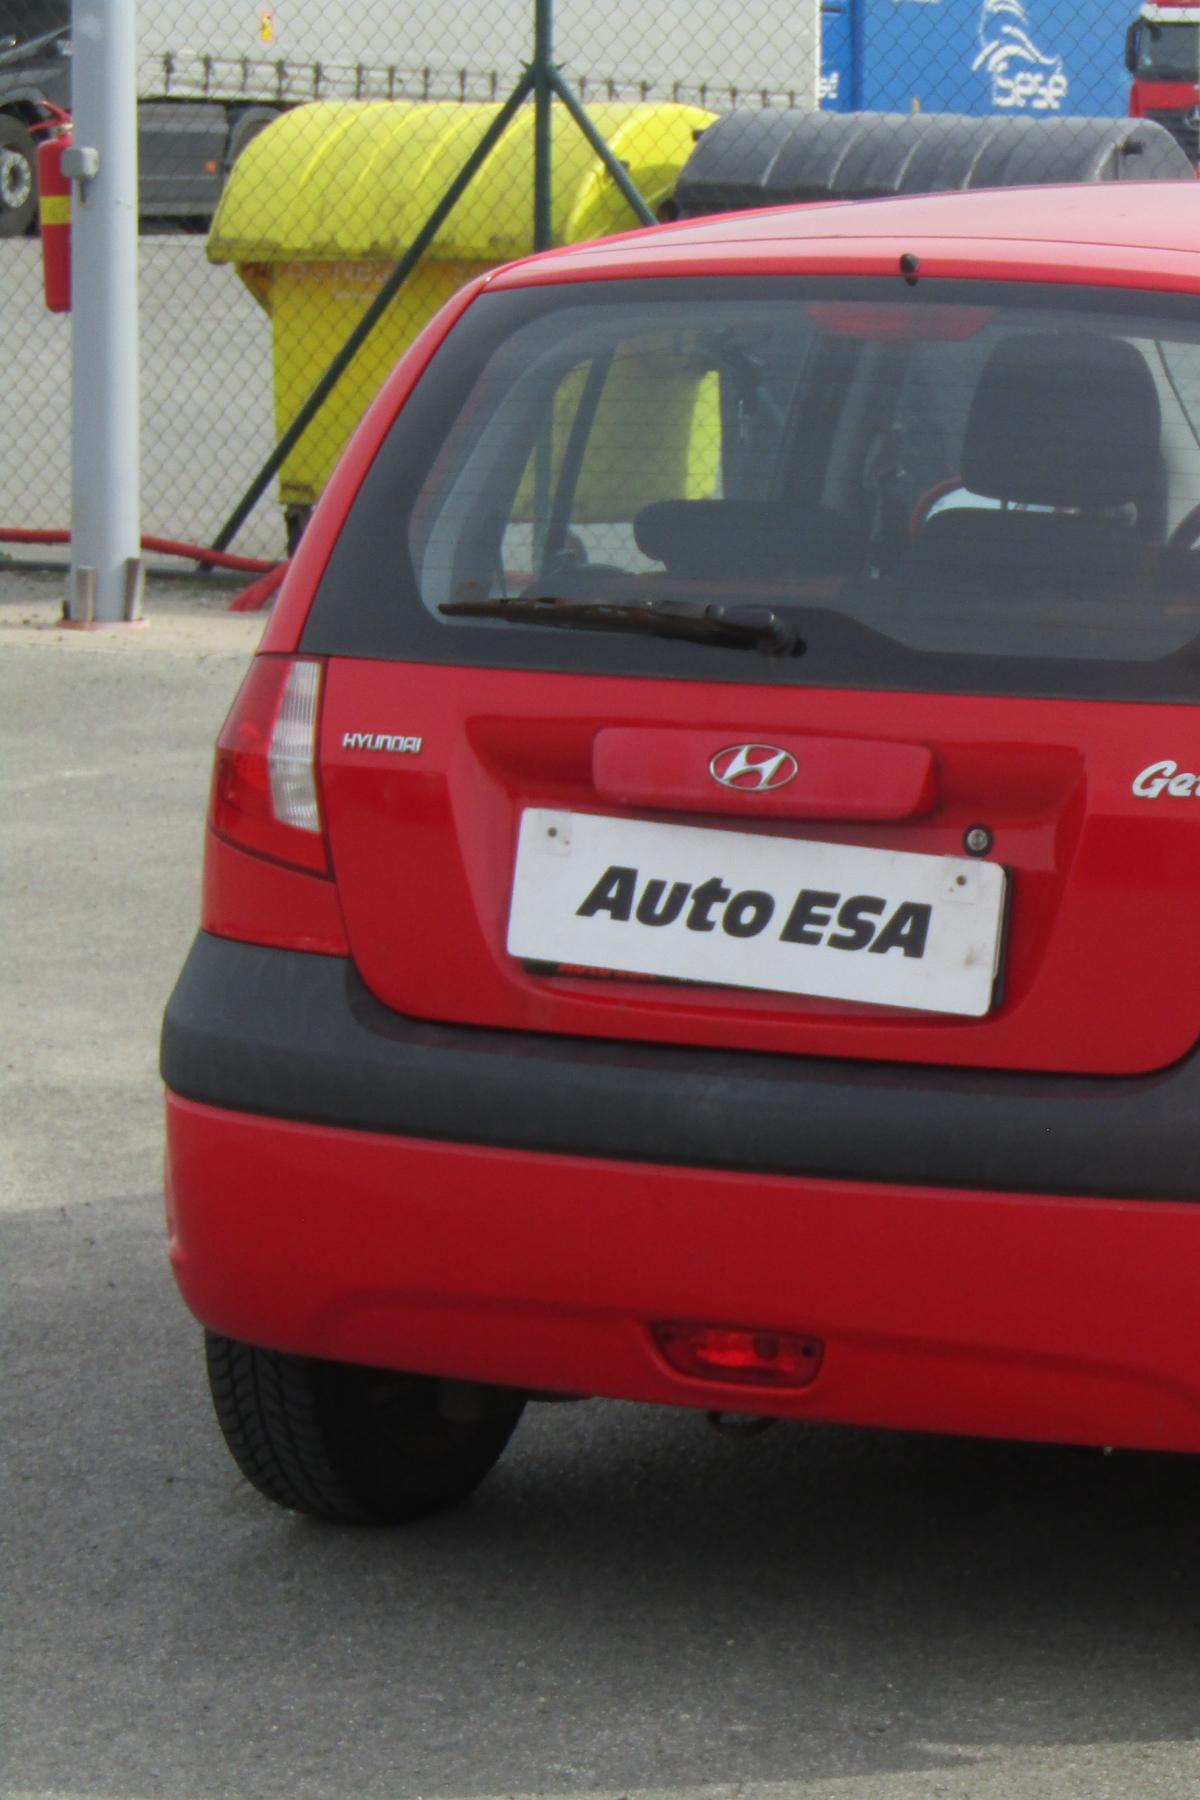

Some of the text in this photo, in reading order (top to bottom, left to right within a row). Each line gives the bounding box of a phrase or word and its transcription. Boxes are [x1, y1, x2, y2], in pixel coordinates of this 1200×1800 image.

[342, 732, 422, 753] HYUNDAI
[575, 864, 933, 959] Auto ESA
